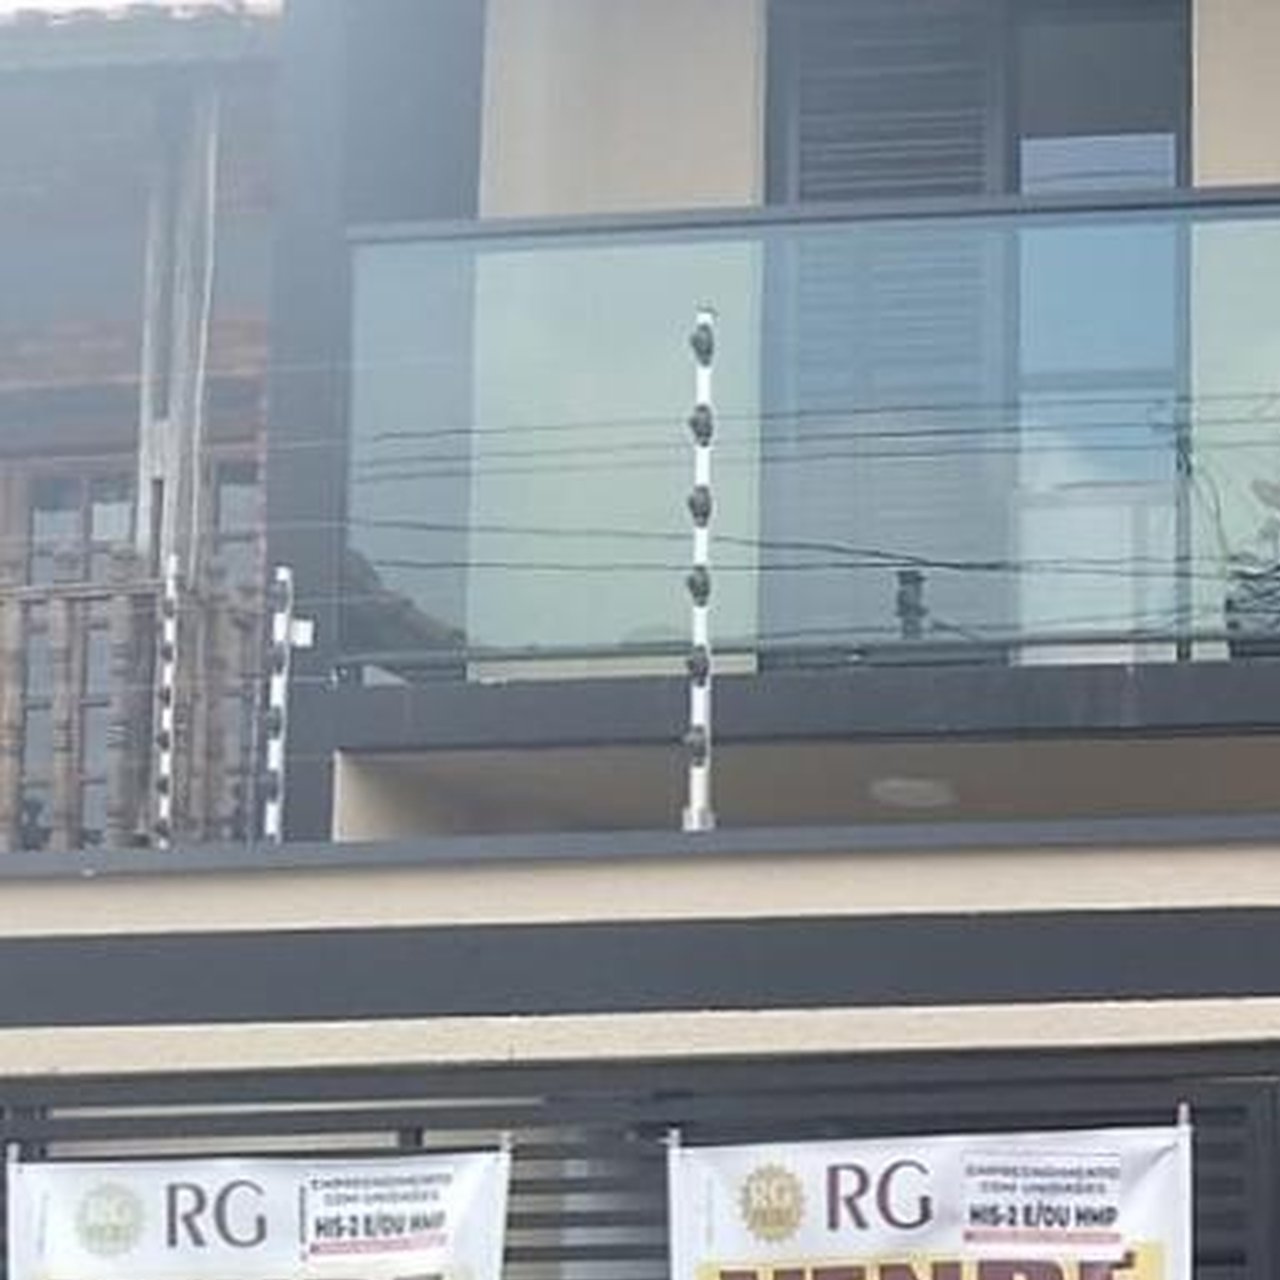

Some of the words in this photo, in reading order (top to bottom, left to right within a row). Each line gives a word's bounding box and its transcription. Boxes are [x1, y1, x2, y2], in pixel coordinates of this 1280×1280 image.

[166, 1180, 267, 1249] RG
[826, 1159, 931, 1232] RG
[969, 1203, 1017, 1227] HIS-2
